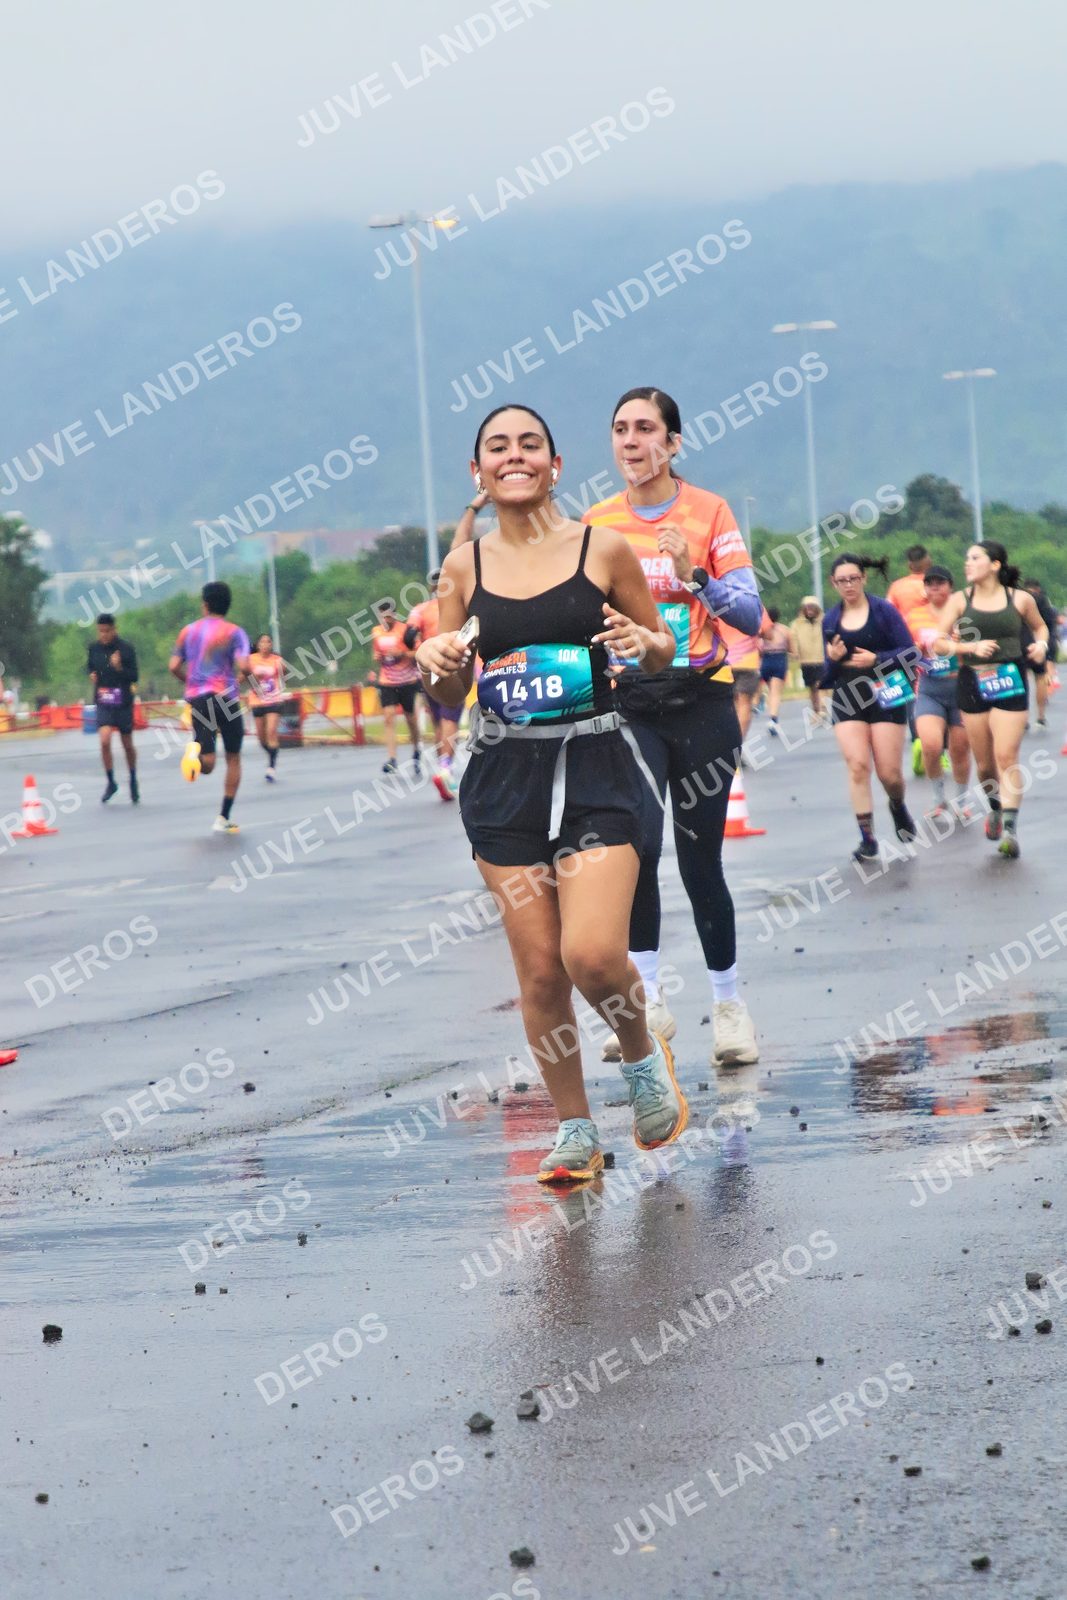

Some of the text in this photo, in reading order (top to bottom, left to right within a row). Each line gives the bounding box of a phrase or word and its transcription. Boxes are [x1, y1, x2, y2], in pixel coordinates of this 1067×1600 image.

[664, 607, 682, 621] 10K
[558, 648, 579, 663] 10K
[495, 675, 564, 703] 1418
[985, 675, 1014, 692] 1510
